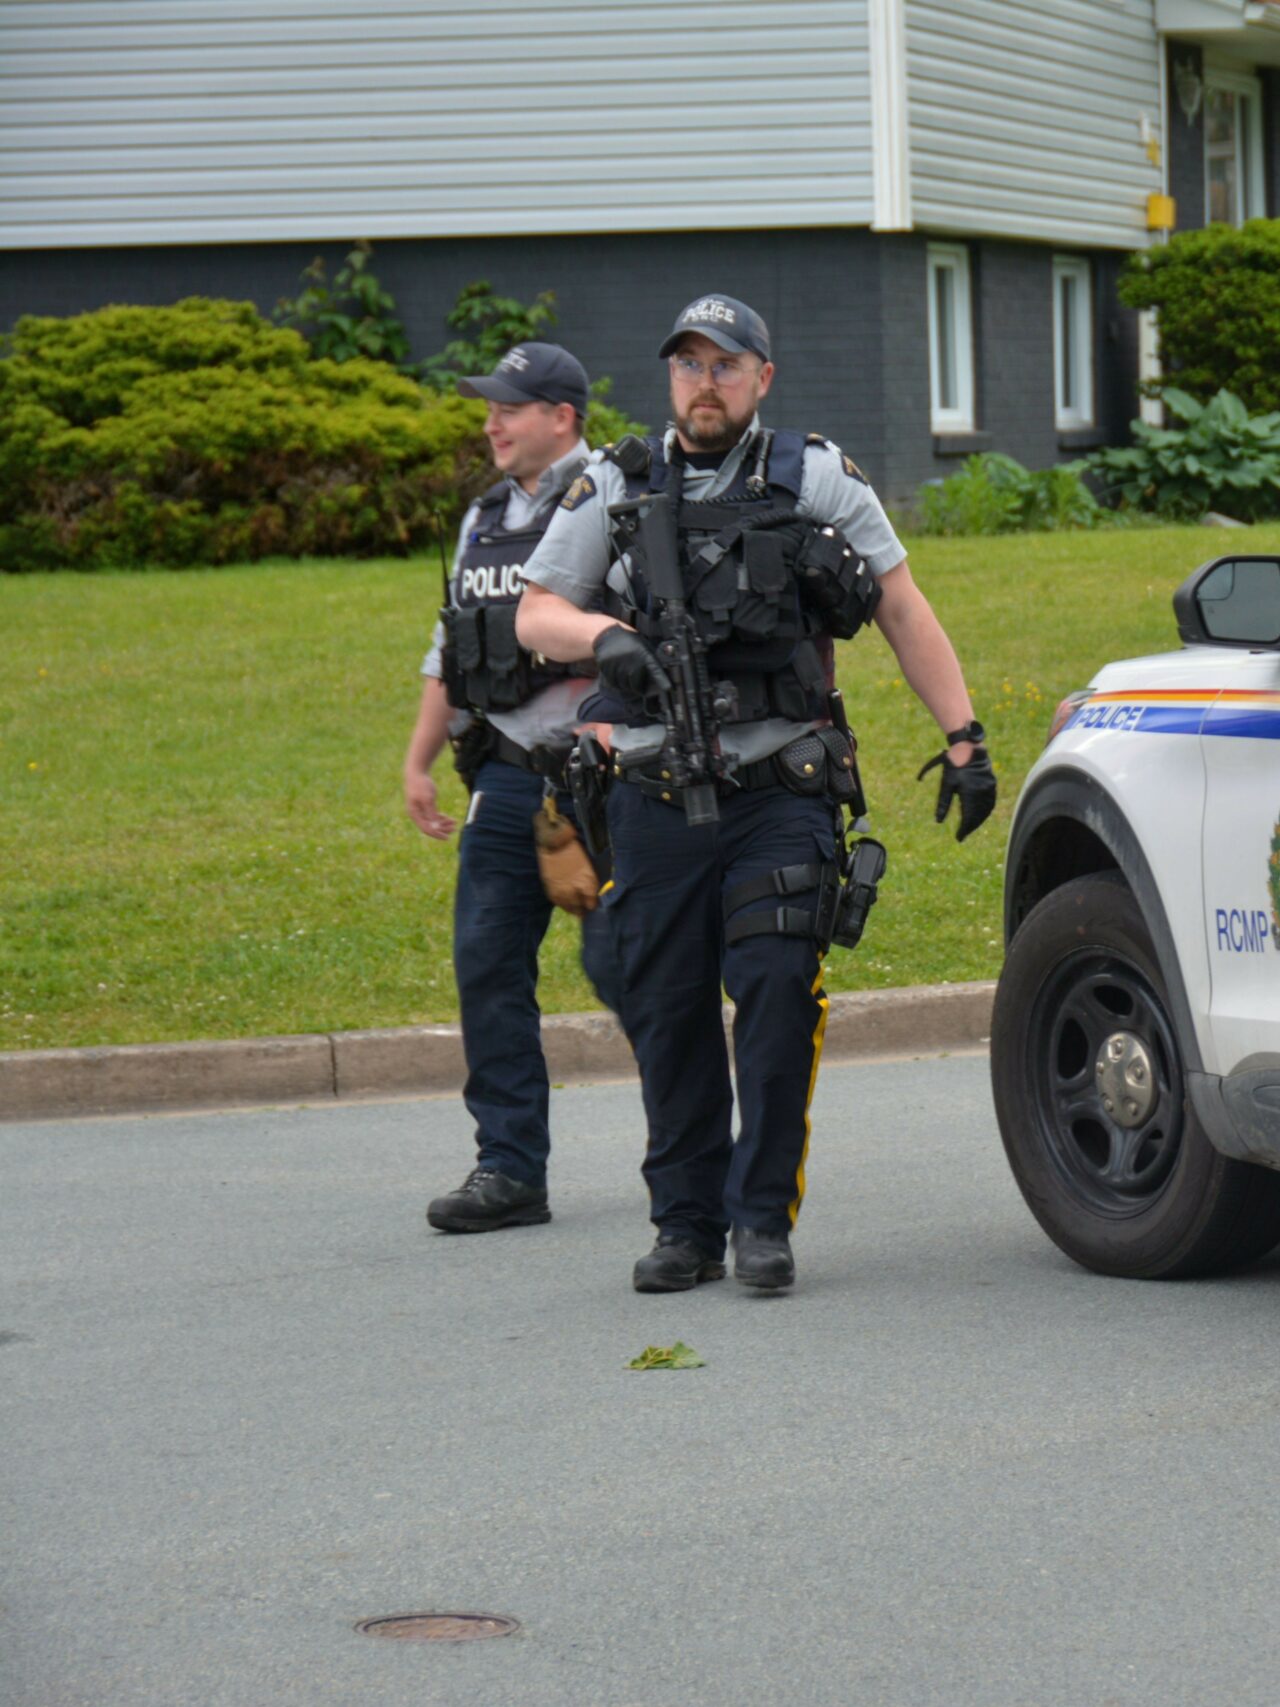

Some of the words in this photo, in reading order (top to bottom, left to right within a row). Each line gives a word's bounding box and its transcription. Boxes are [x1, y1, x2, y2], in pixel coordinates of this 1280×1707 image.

[462, 563, 528, 599] POLIC
[1072, 706, 1144, 731] POLICE
[1216, 909, 1268, 953] RCMP
